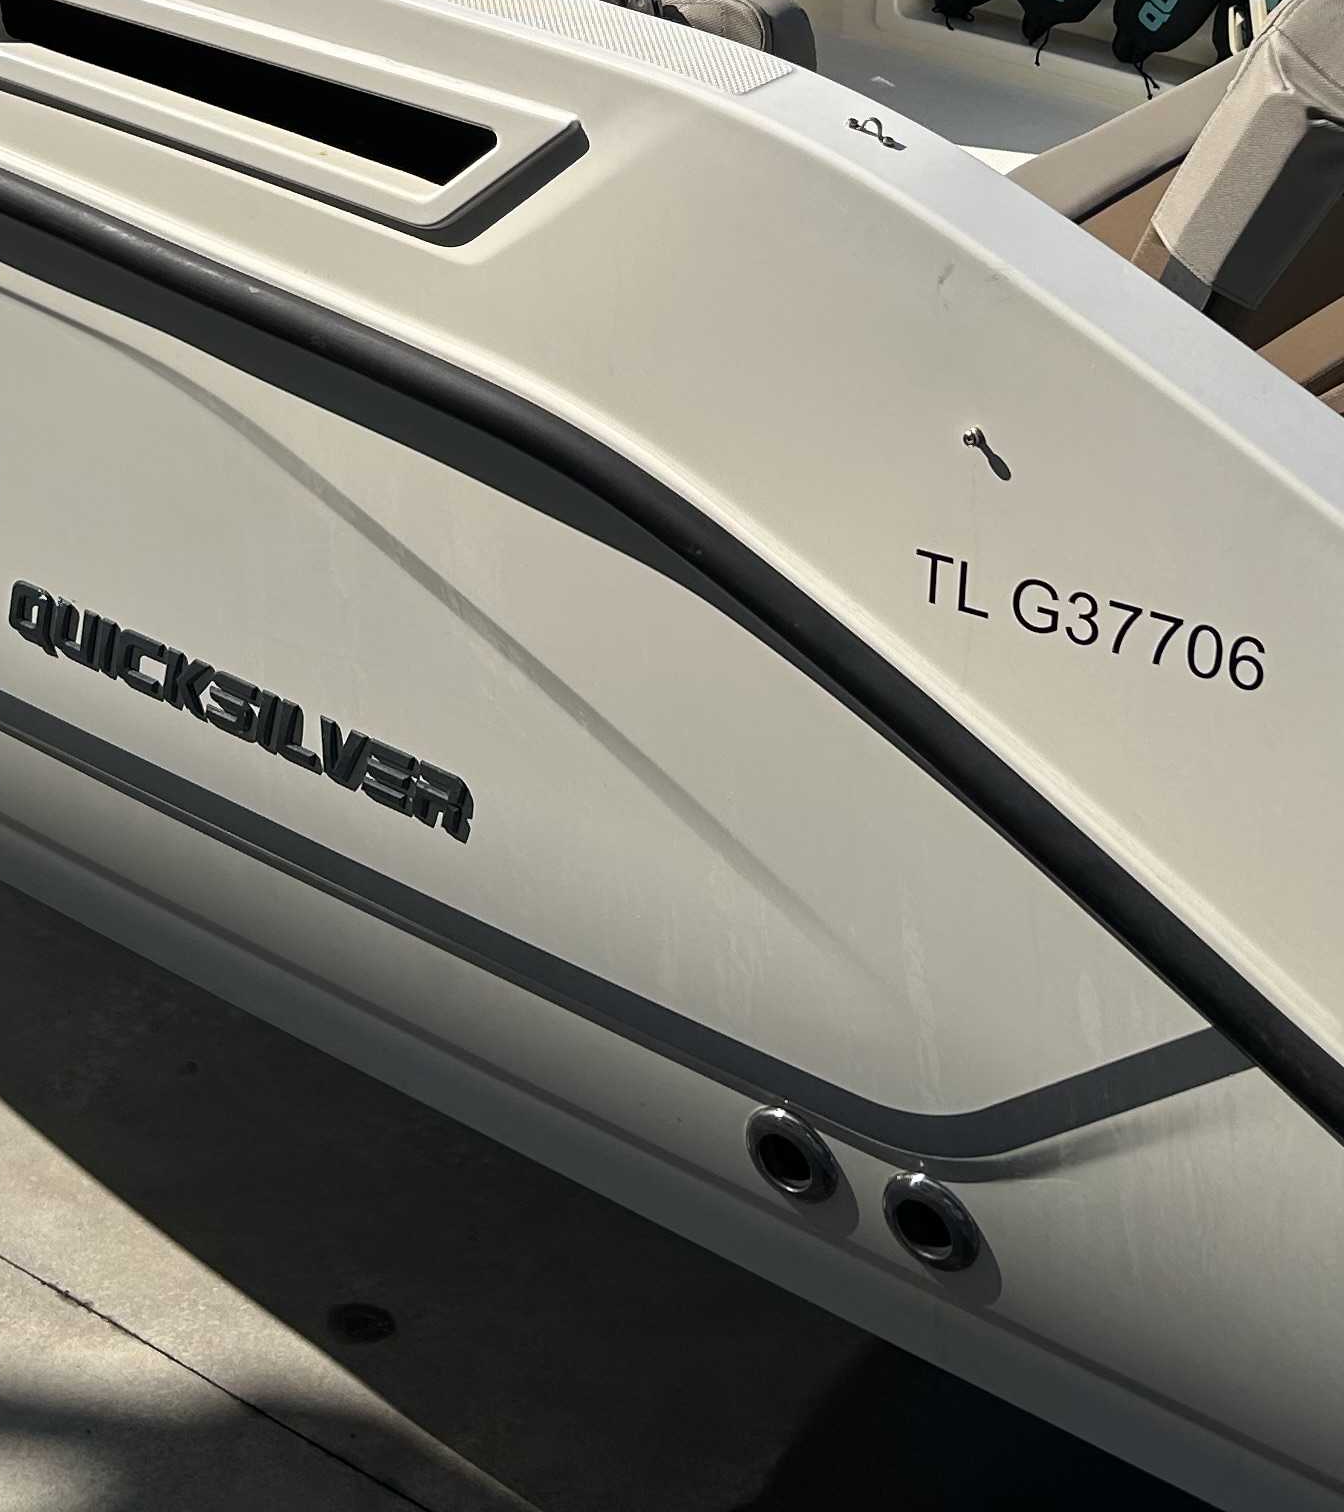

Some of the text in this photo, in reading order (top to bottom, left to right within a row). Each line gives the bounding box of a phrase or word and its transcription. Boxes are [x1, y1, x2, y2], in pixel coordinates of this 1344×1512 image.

[8, 579, 475, 845] QUICKSILVER
[915, 548, 1267, 691] TL G37706
